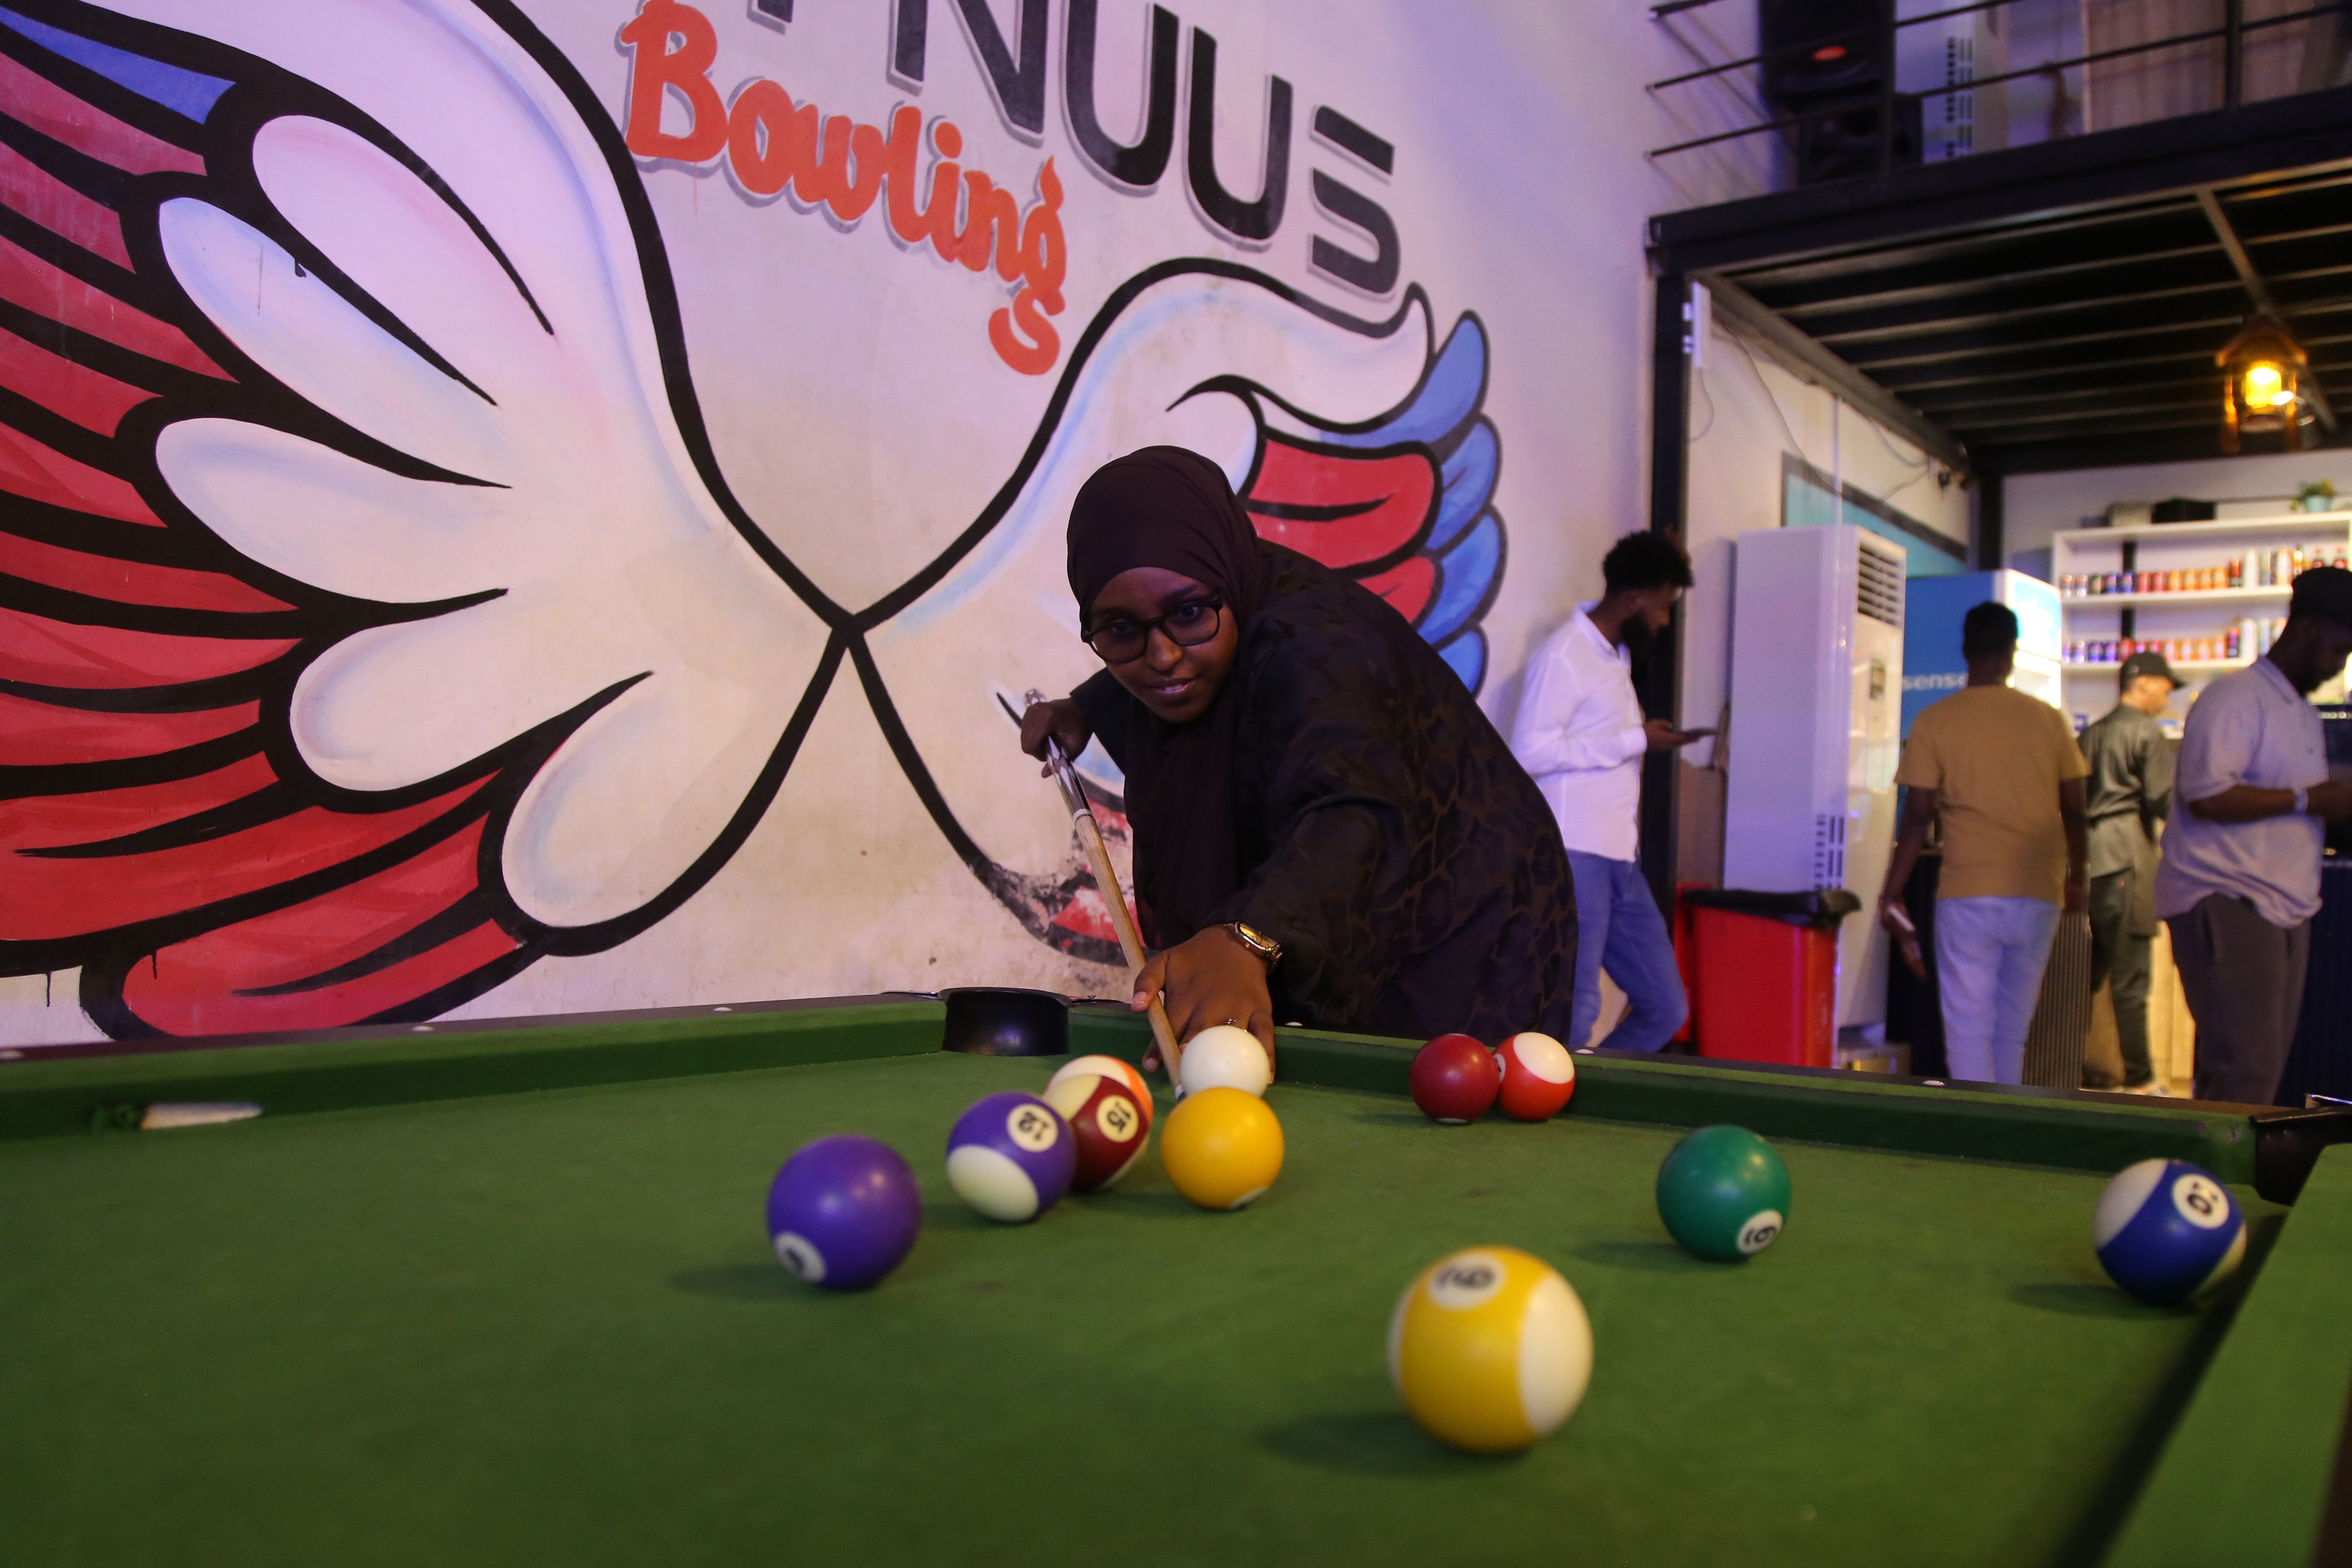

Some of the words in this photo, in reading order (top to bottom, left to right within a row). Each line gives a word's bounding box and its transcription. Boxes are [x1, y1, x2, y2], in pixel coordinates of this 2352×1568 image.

[1019, 1111, 1049, 1142] 12
[1106, 1101, 1132, 1133] 15
[2188, 1181, 2218, 1217] 10
